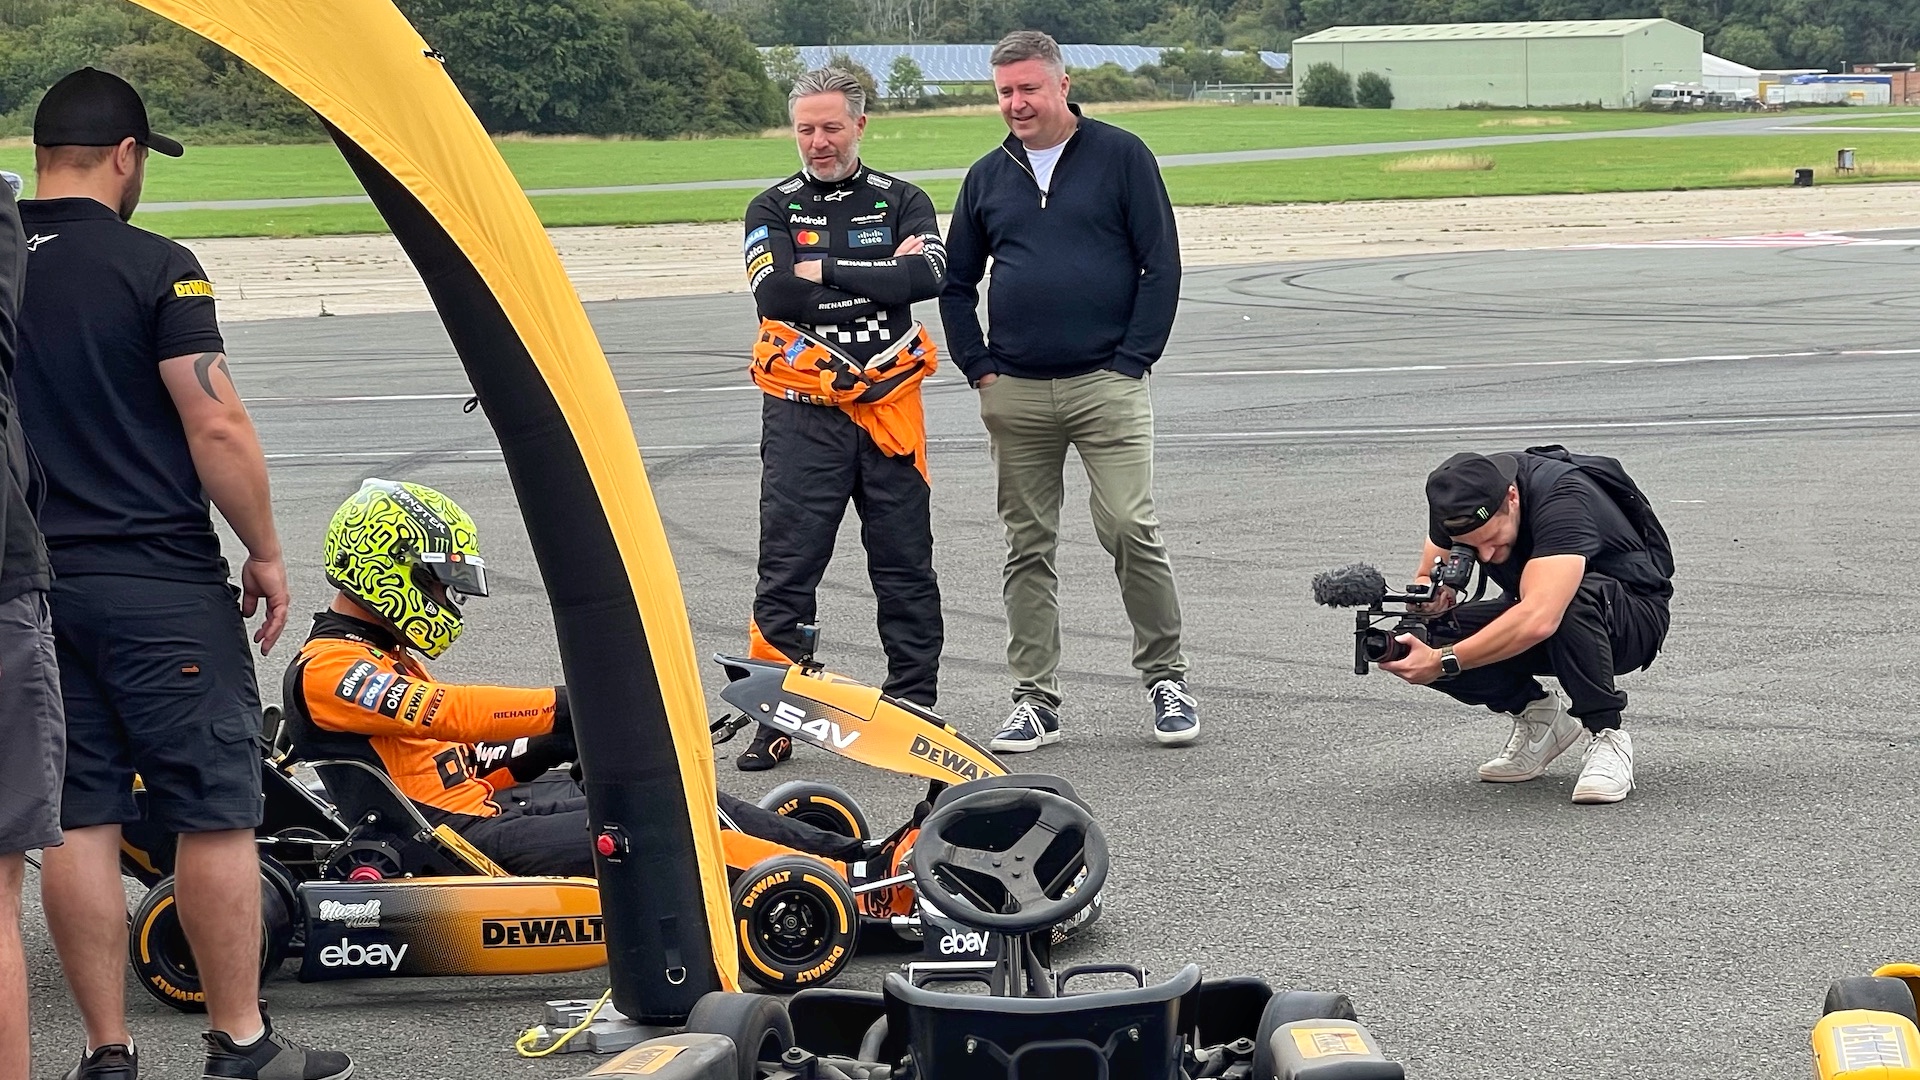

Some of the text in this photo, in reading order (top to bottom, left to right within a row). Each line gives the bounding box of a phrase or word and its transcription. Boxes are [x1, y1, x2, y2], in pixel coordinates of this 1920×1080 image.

[790, 214, 827, 226] Android
[818, 297, 873, 310] RICHARD MILL
[342, 662, 372, 697] allwyn
[362, 673, 391, 707] ECOLA
[386, 683, 409, 710] okta
[494, 709, 538, 719] RICHARD
[773, 701, 861, 749] 54V
[910, 735, 989, 781] DEWA
[320, 937, 409, 971] ebay
[939, 928, 990, 956] ebay
